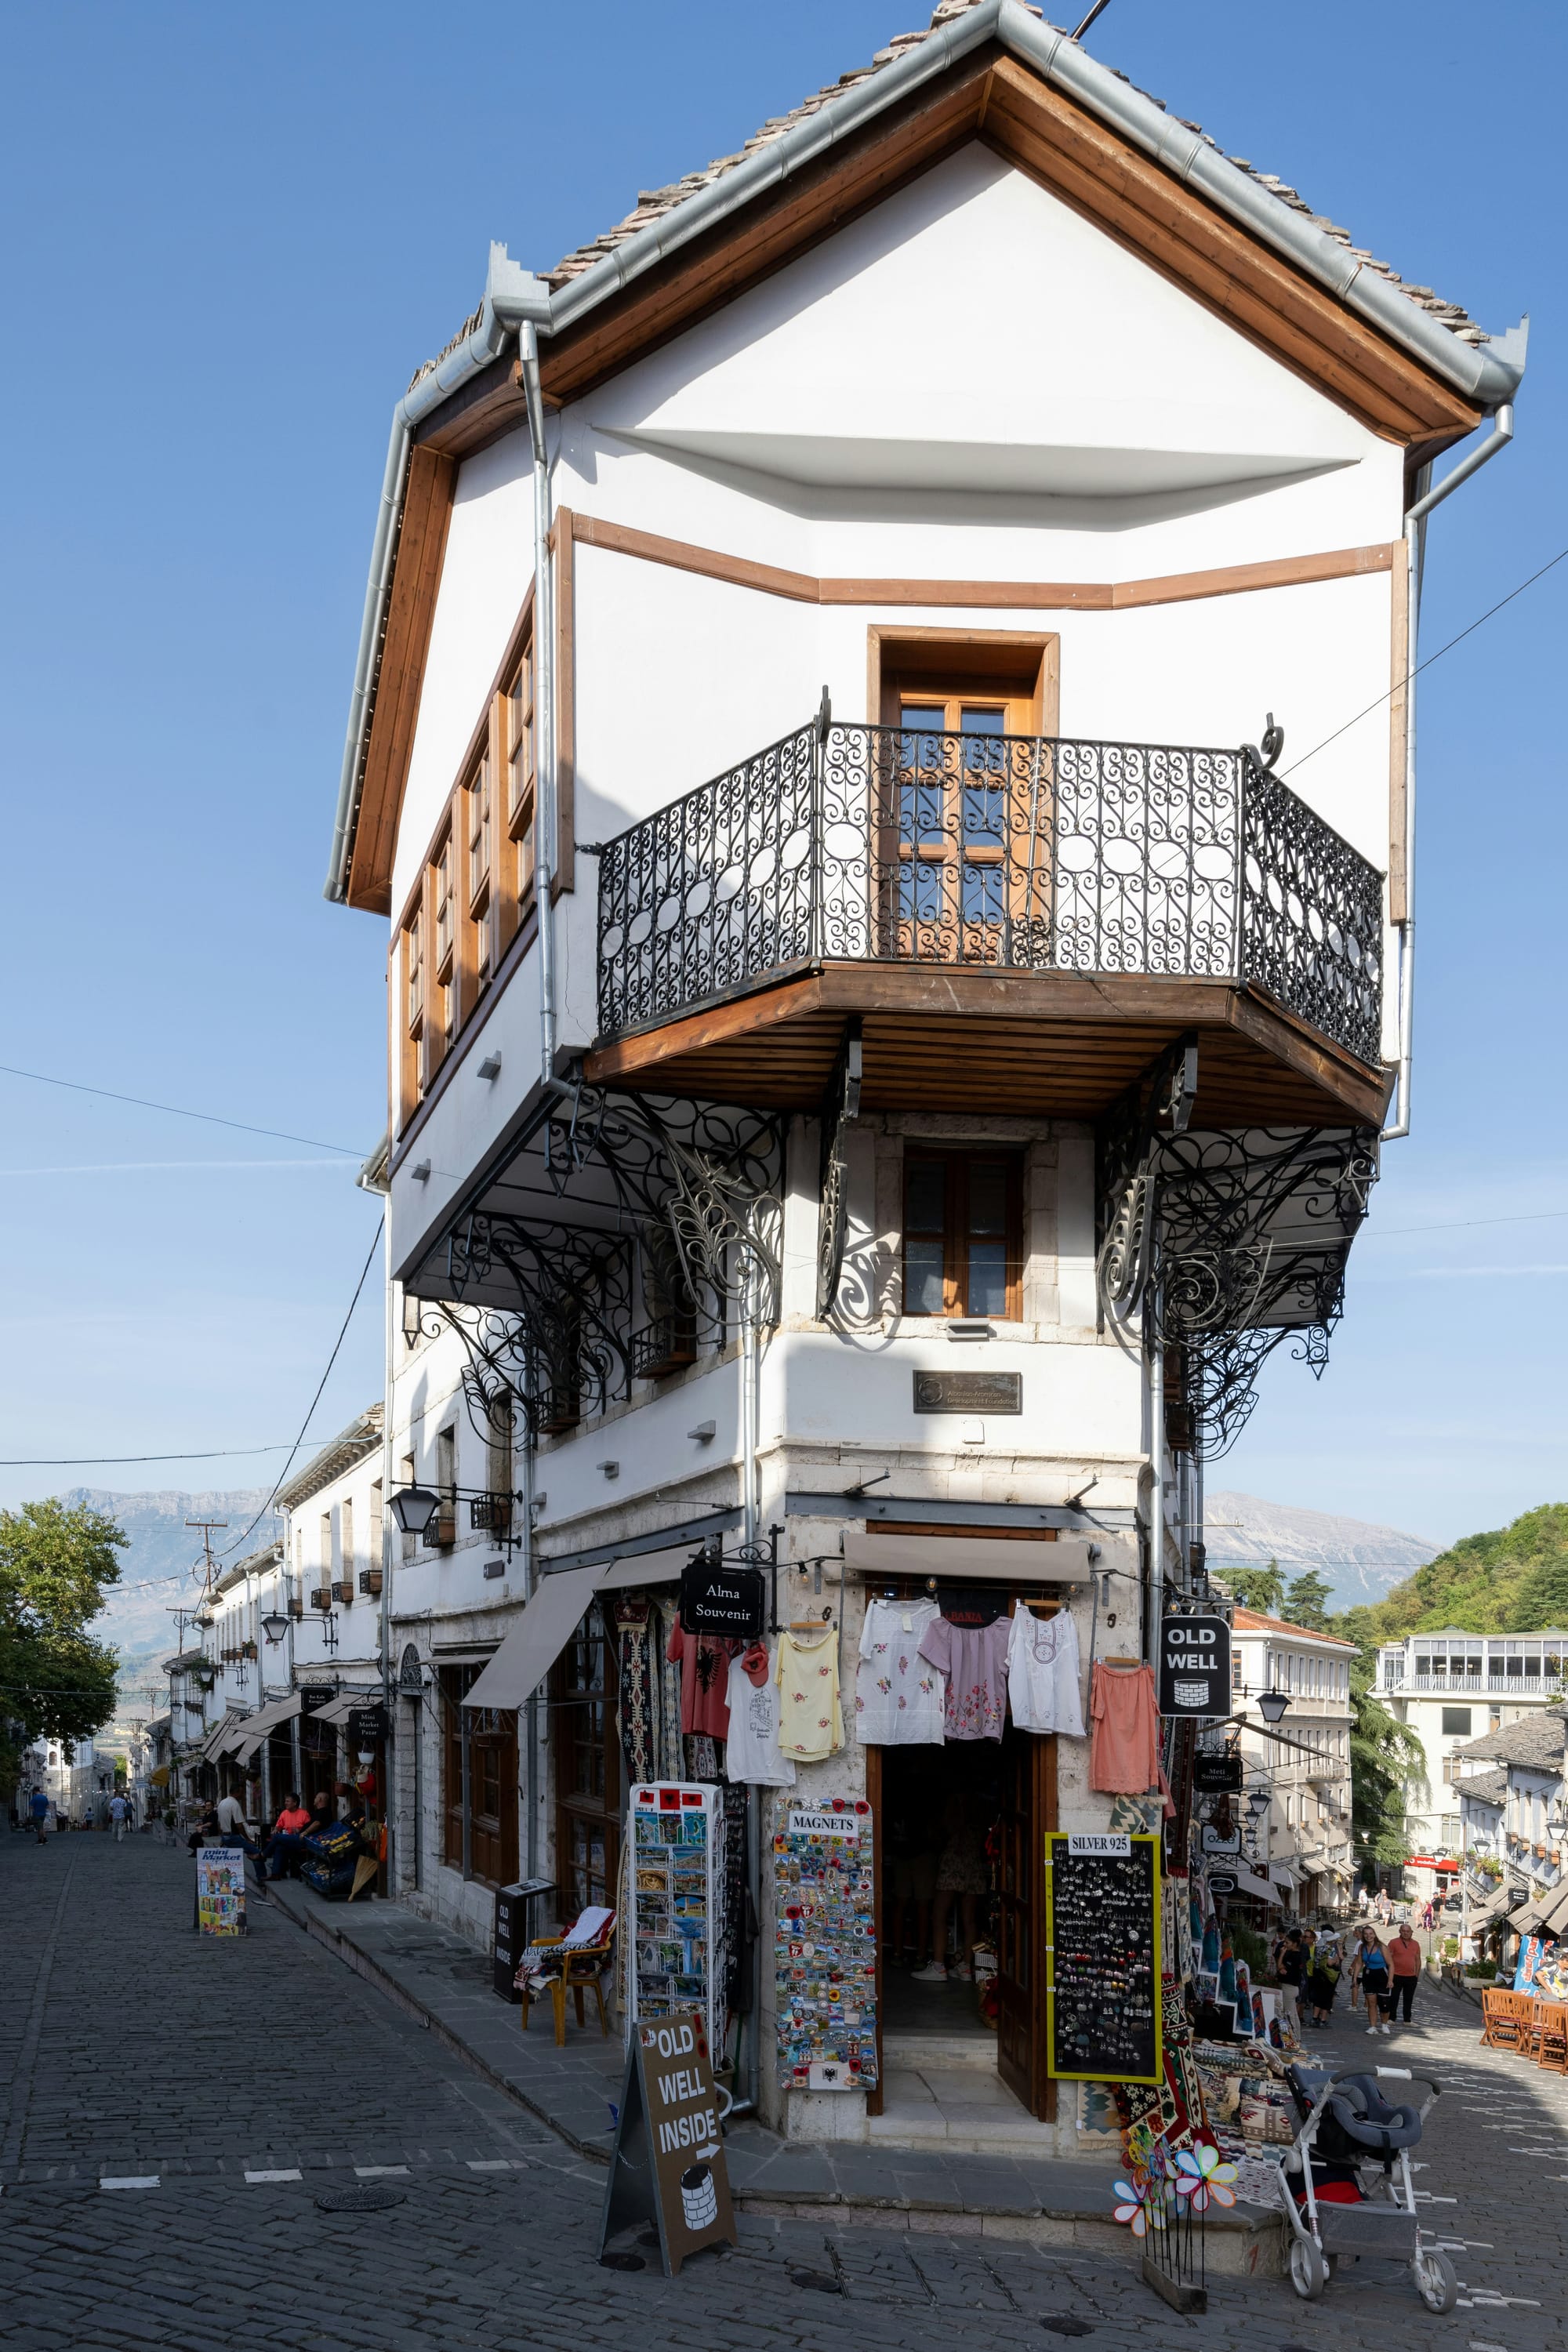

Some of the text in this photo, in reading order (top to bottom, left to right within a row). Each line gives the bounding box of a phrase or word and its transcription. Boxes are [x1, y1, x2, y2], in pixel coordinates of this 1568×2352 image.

[706, 1584, 740, 1599] Alma
[696, 1604, 751, 1620] Souvenir
[1167, 1629, 1216, 1644] OLD
[1167, 1653, 1218, 1669] WELL
[793, 1816, 854, 1831] MAGNETS
[1073, 1837, 1127, 1850] SILVER 925
[499, 1904, 509, 1919] OLD
[498, 1922, 510, 1939] WELL
[496, 1946, 511, 1965] INSIDE
[658, 2025, 694, 2058] OLD
[658, 2067, 706, 2105] WELL
[659, 2108, 717, 2154] INSIDE
